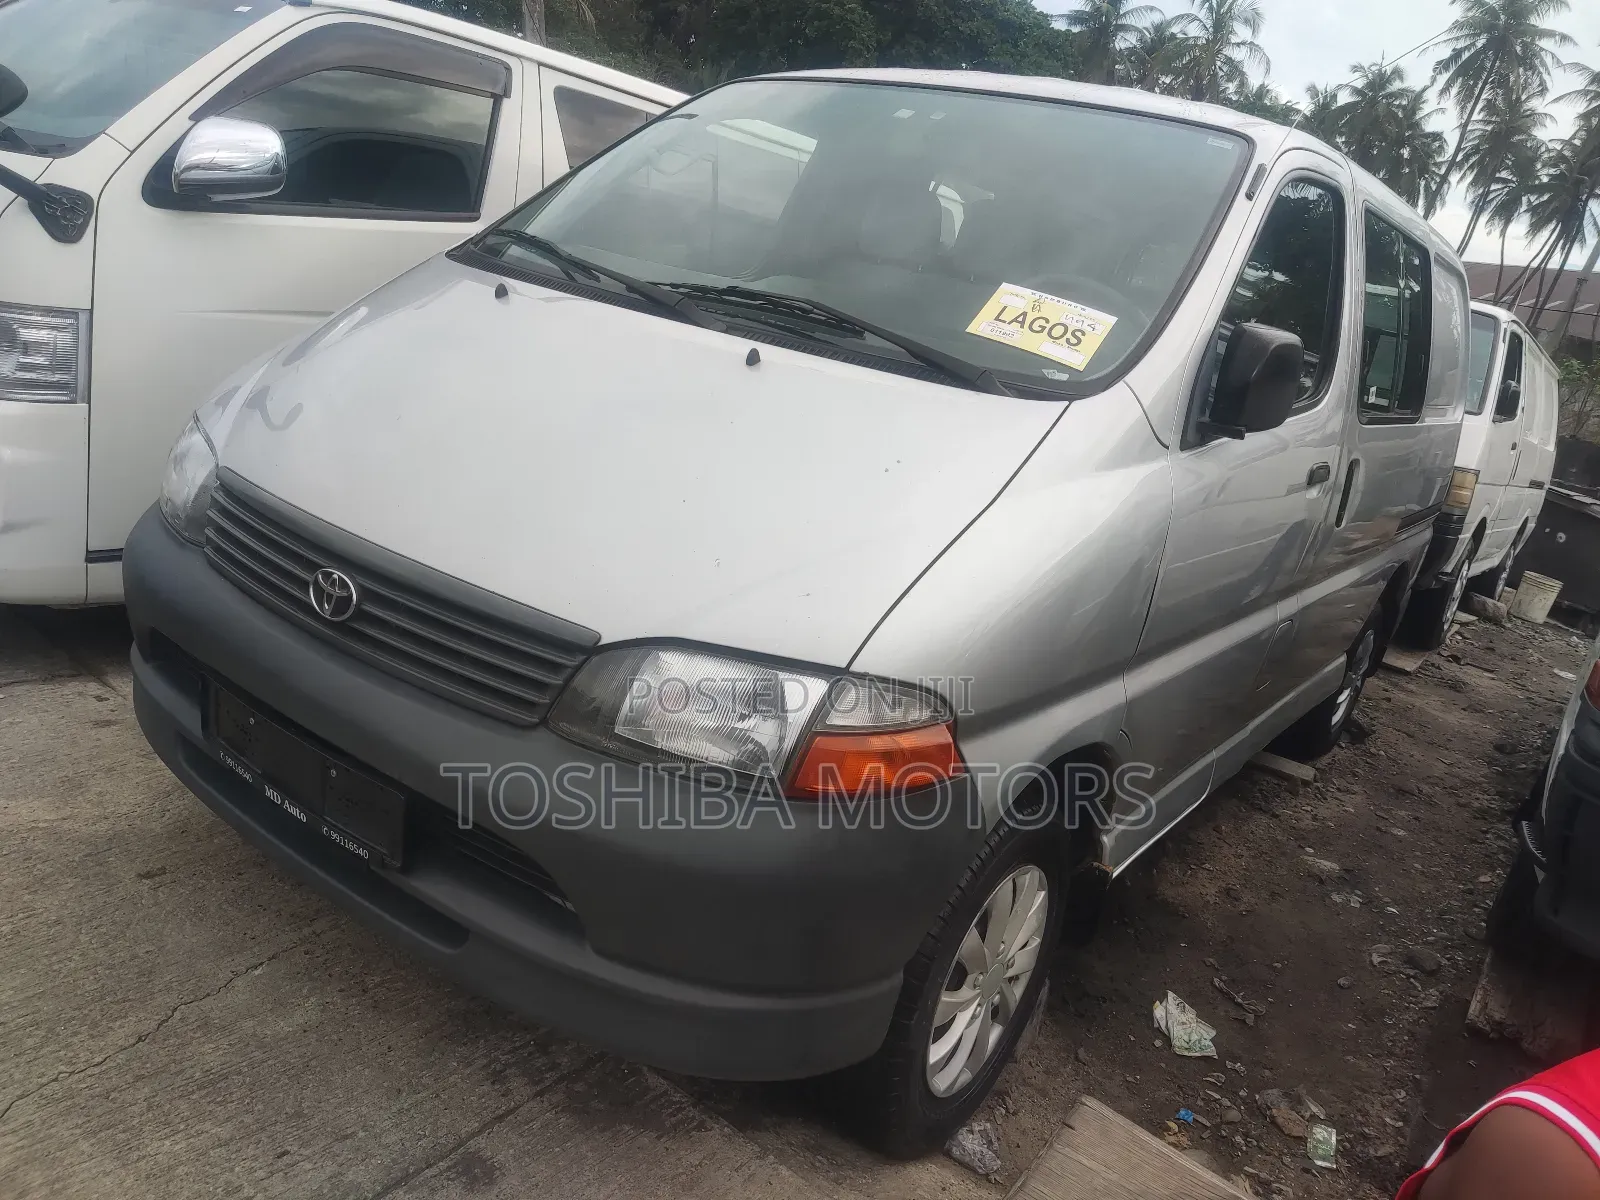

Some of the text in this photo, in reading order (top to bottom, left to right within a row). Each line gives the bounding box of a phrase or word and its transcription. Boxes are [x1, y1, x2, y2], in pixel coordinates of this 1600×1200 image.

[993, 305, 1086, 347] LAGOS
[225, 755, 253, 783] 99116540
[264, 784, 307, 823] MD Auto
[330, 830, 369, 860] 99116540
